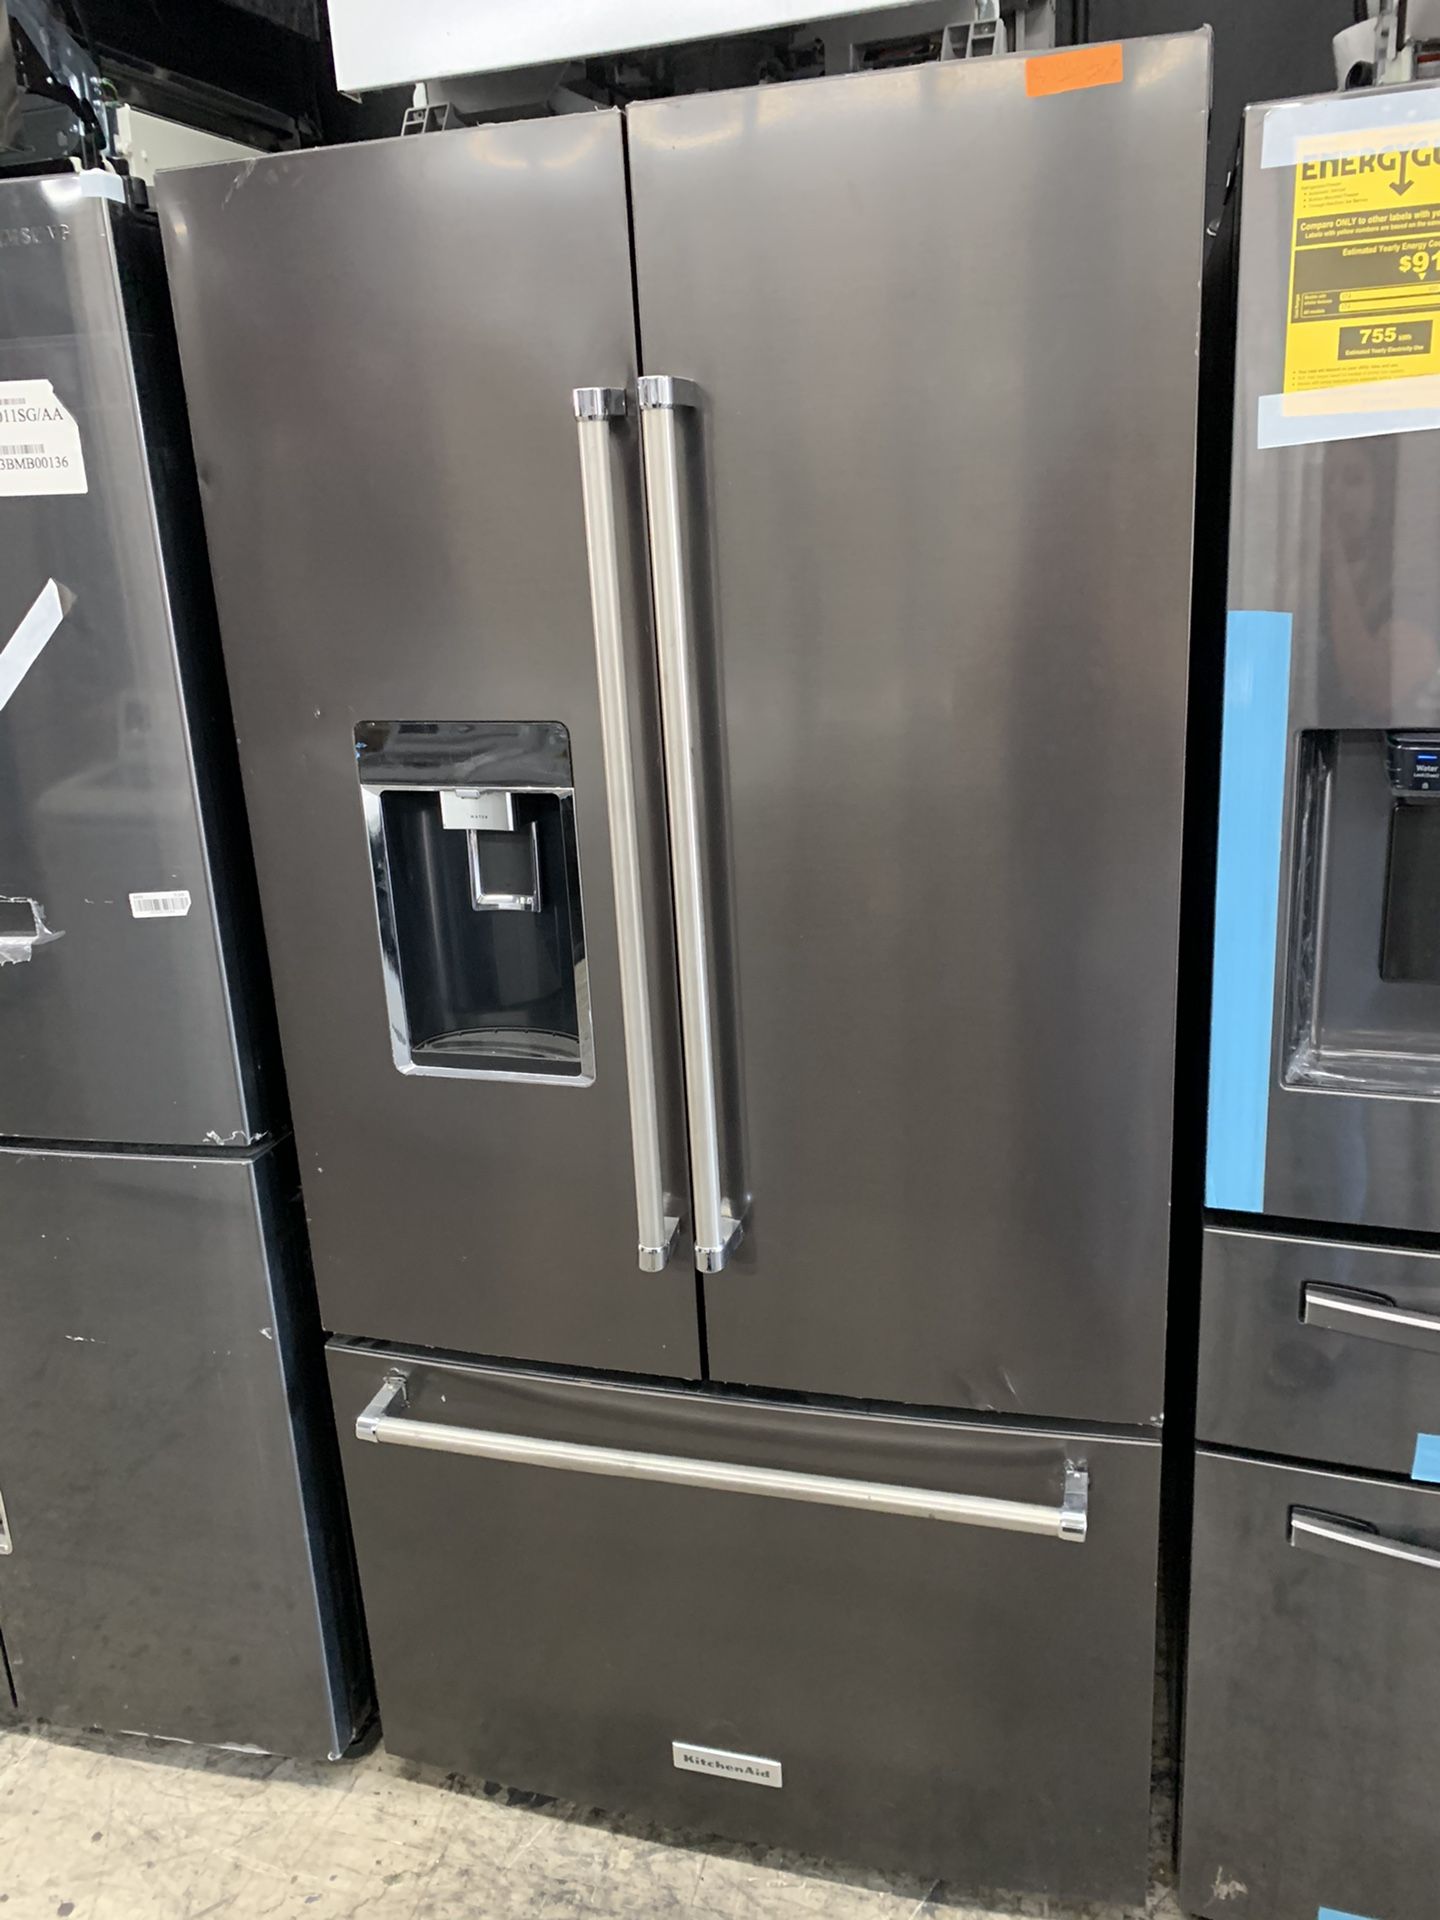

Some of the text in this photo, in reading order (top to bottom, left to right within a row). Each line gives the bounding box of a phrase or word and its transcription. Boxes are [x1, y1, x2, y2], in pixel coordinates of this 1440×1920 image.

[1300, 221, 1334, 232] Compare
[1336, 217, 1357, 228] ONLY
[1358, 217, 1366, 225] to
[1368, 215, 1388, 224] other
[1389, 212, 1412, 222] labels
[1414, 210, 1431, 218] with
[1342, 246, 1377, 256] Estimated
[1379, 243, 1400, 253] Yearly
[1402, 241, 1427, 250] Energy
[1399, 250, 1440, 273] $91
[1360, 327, 1397, 344] 755
[0, 456, 69, 470] 3BMB00136
[683, 1754, 770, 1778] KitchenAid
